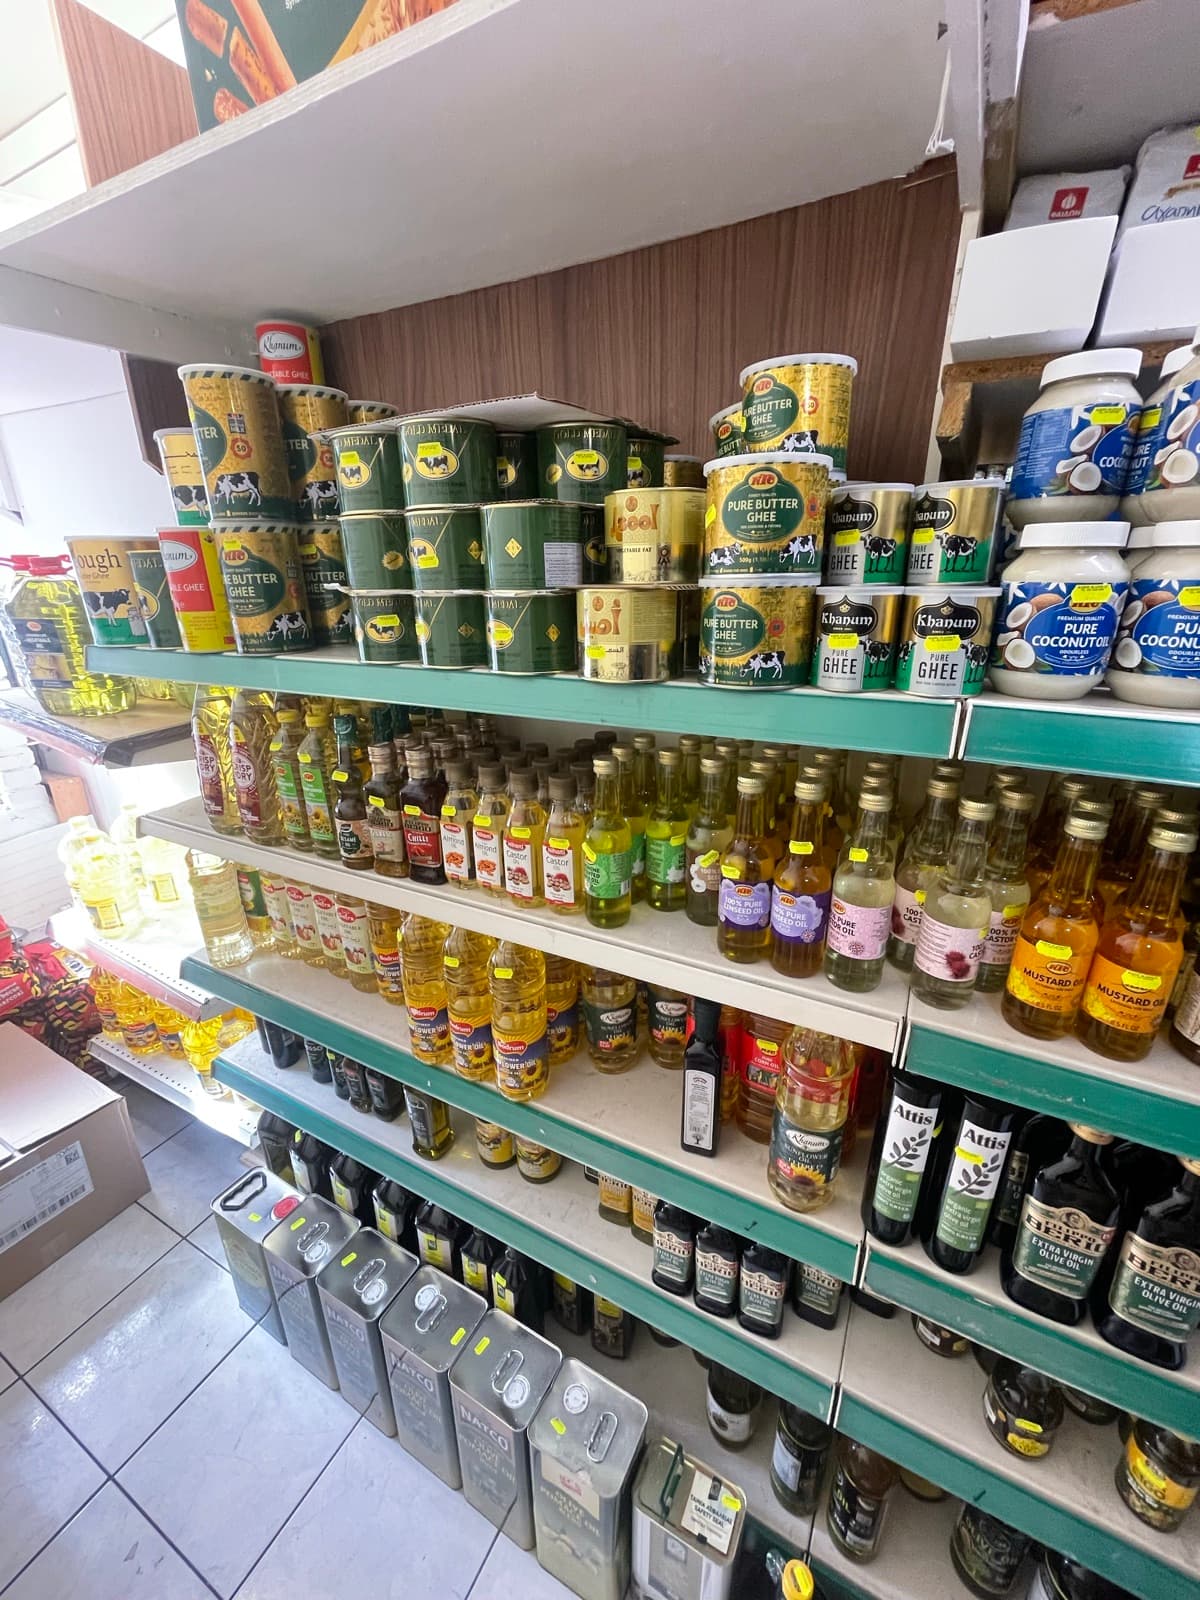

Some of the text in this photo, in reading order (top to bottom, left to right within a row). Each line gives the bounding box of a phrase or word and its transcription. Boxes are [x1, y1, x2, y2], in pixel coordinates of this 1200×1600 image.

[757, 398, 792, 413] BUTTER
[752, 413, 773, 426] GHEE
[727, 499, 798, 512] PURE BUTTER
[746, 511, 777, 522] GHEE
[831, 552, 858, 570] GHEE
[232, 572, 279, 584] BUTTER
[184, 583, 205, 591] GHEE
[229, 586, 255, 597] GHEE
[719, 619, 758, 629] BUTTER
[821, 612, 872, 627] Khanum
[916, 613, 976, 629] Khanum
[713, 630, 737, 640] GHEE
[1063, 623, 1099, 635] PURE
[1031, 635, 1110, 648] COCONUT OIL
[930, 653, 949, 662] PURE
[823, 657, 857, 674] GHEE
[918, 663, 958, 680] GHEE
[443, 834, 465, 846] Almond
[475, 842, 497, 854] Almond
[506, 848, 528, 861] Castor
[545, 855, 569, 867] Castor
[723, 903, 752, 915] LINSEED
[786, 912, 807, 922] PURE
[837, 916, 857, 930] PURE
[795, 919, 809, 929] OIL
[842, 925, 856, 937] OIL
[1023, 967, 1072, 988] MUSTARD
[1097, 983, 1151, 1007] MUSTARD
[893, 1103, 934, 1126] Attis
[792, 1133, 825, 1147] Khanum
[963, 1128, 1007, 1151] Attis
[1032, 1236, 1095, 1266] EXTRA VIRGIN
[1039, 1249, 1080, 1271] OLIVE OIL
[1134, 1275, 1167, 1298] EXTRA
[1142, 1289, 1188, 1314] OLIVE OIL
[460, 1403, 509, 1451] NATCO
